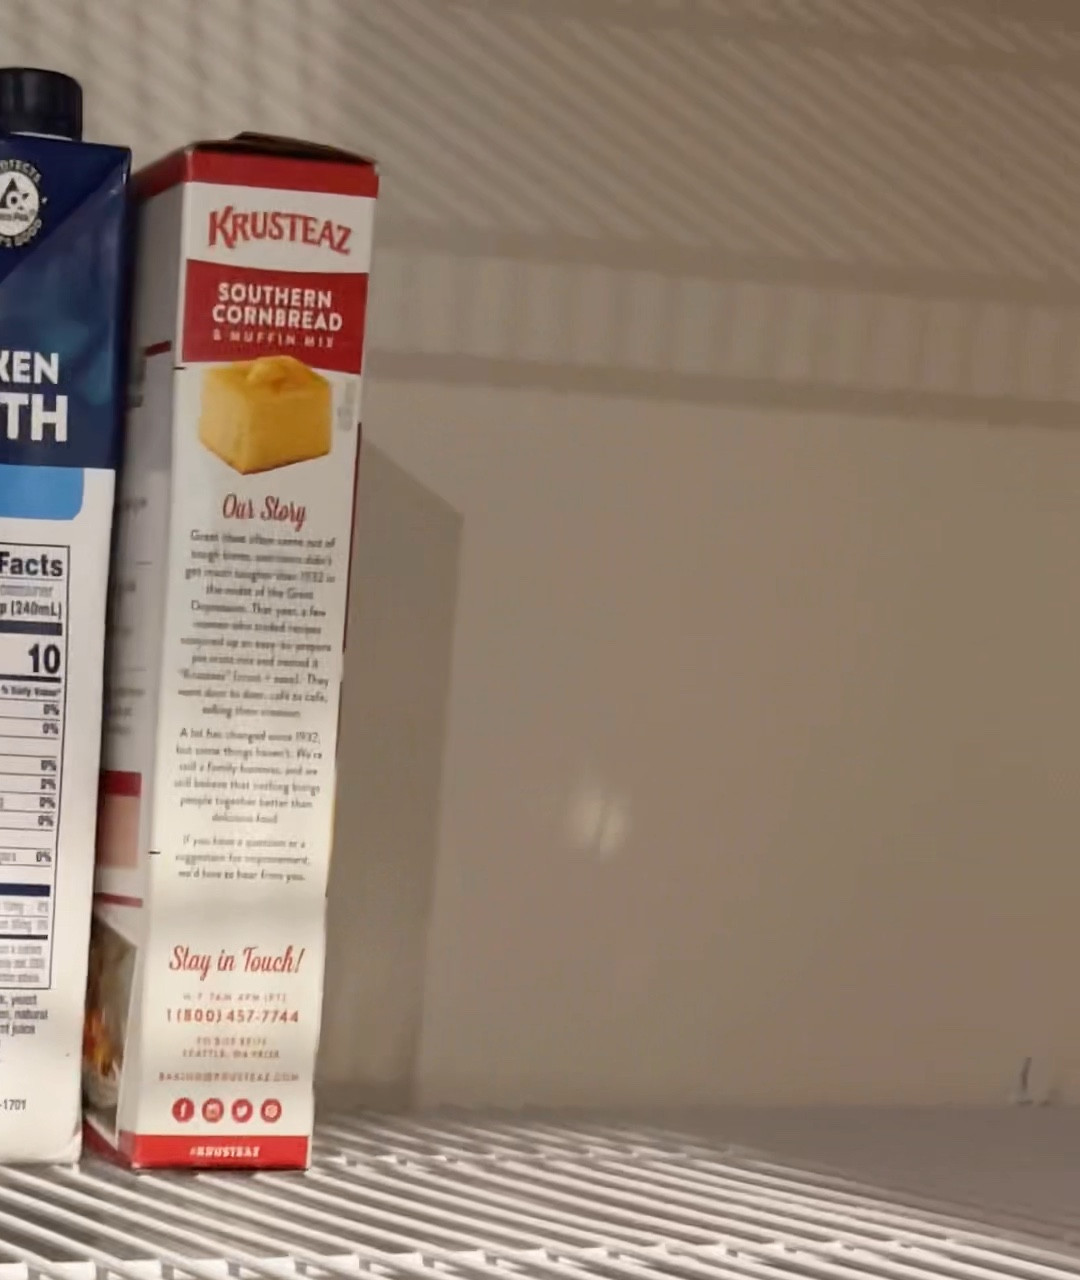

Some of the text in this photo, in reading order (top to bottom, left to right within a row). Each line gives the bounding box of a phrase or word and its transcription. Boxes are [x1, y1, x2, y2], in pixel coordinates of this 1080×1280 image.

[208, 205, 352, 256] KRUSTEAZ
[218, 282, 333, 308] SOUTHERN
[212, 304, 343, 332] CORNBREAD
[230, 331, 296, 346] MUFFIN
[304, 335, 334, 348] MIX
[222, 493, 306, 532] Our Story
[28, 643, 61, 674] 10
[169, 945, 306, 981] Stay in Touch!
[177, 1008, 222, 1023] (800)
[226, 1009, 299, 1023] 457-7744
